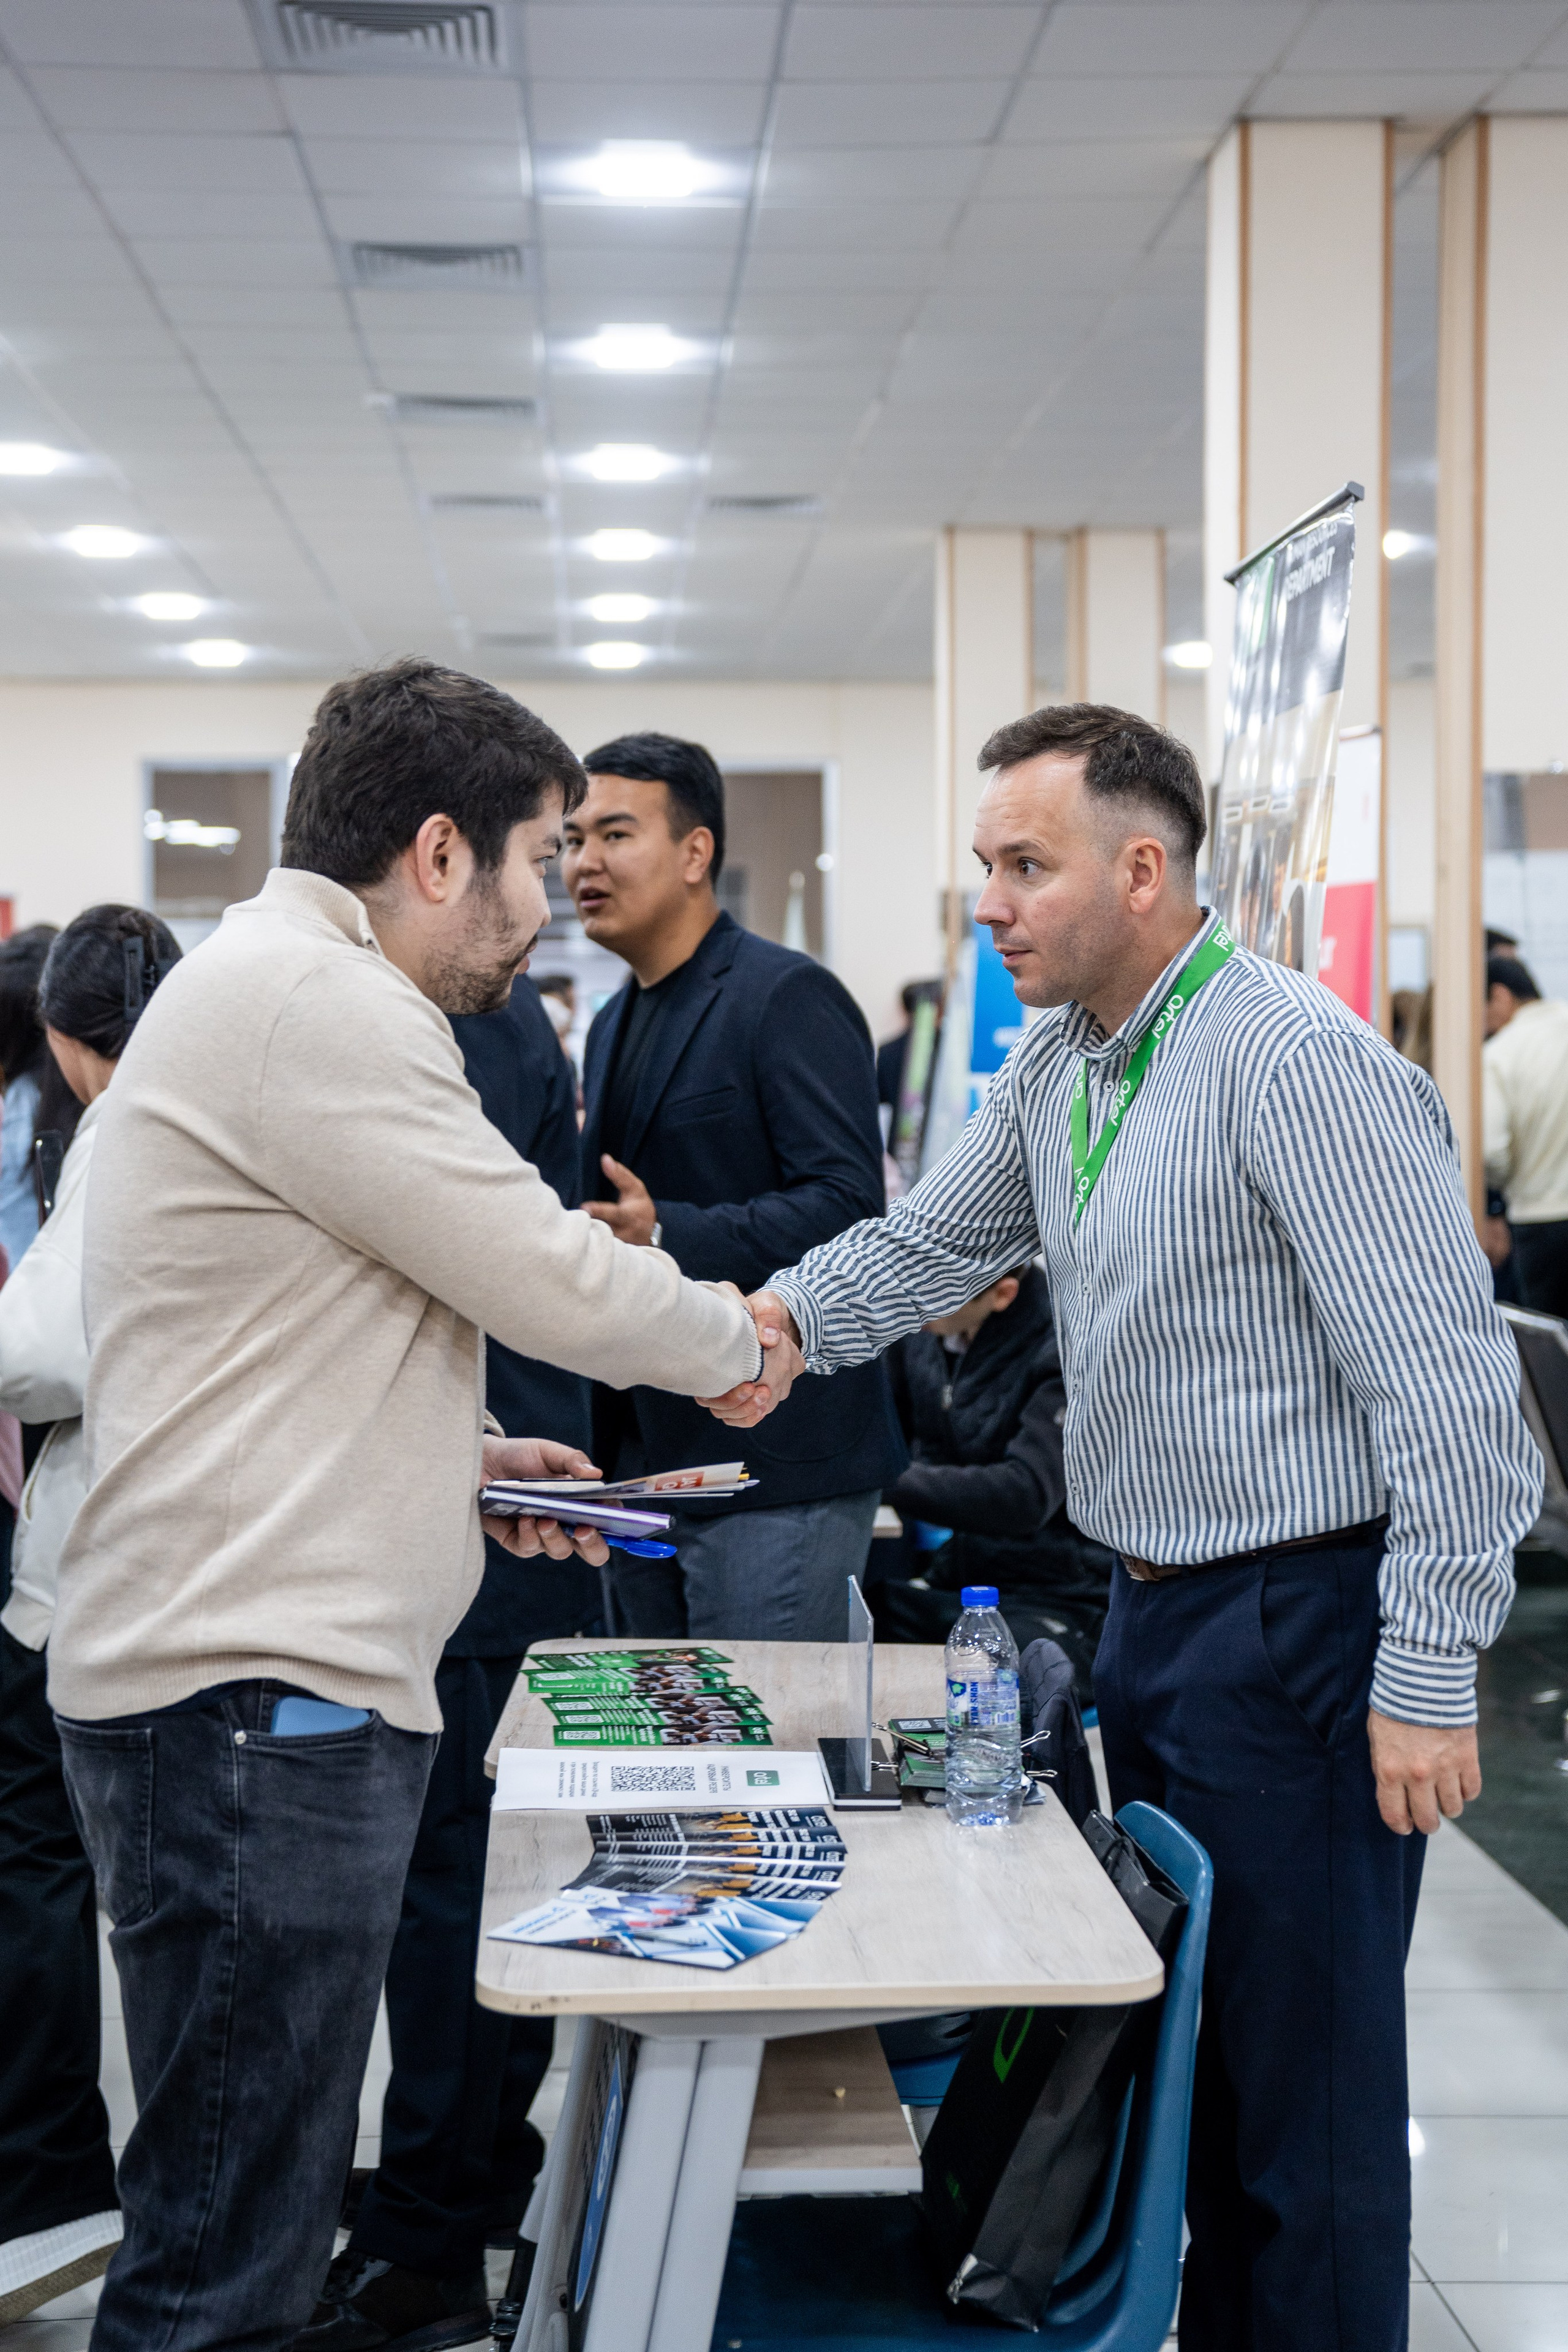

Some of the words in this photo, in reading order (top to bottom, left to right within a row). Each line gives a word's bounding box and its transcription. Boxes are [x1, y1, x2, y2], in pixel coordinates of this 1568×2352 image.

[1152, 995, 1184, 1039] artel
[1110, 1080, 1131, 1126] artel
[1075, 1176, 1090, 1214] art
